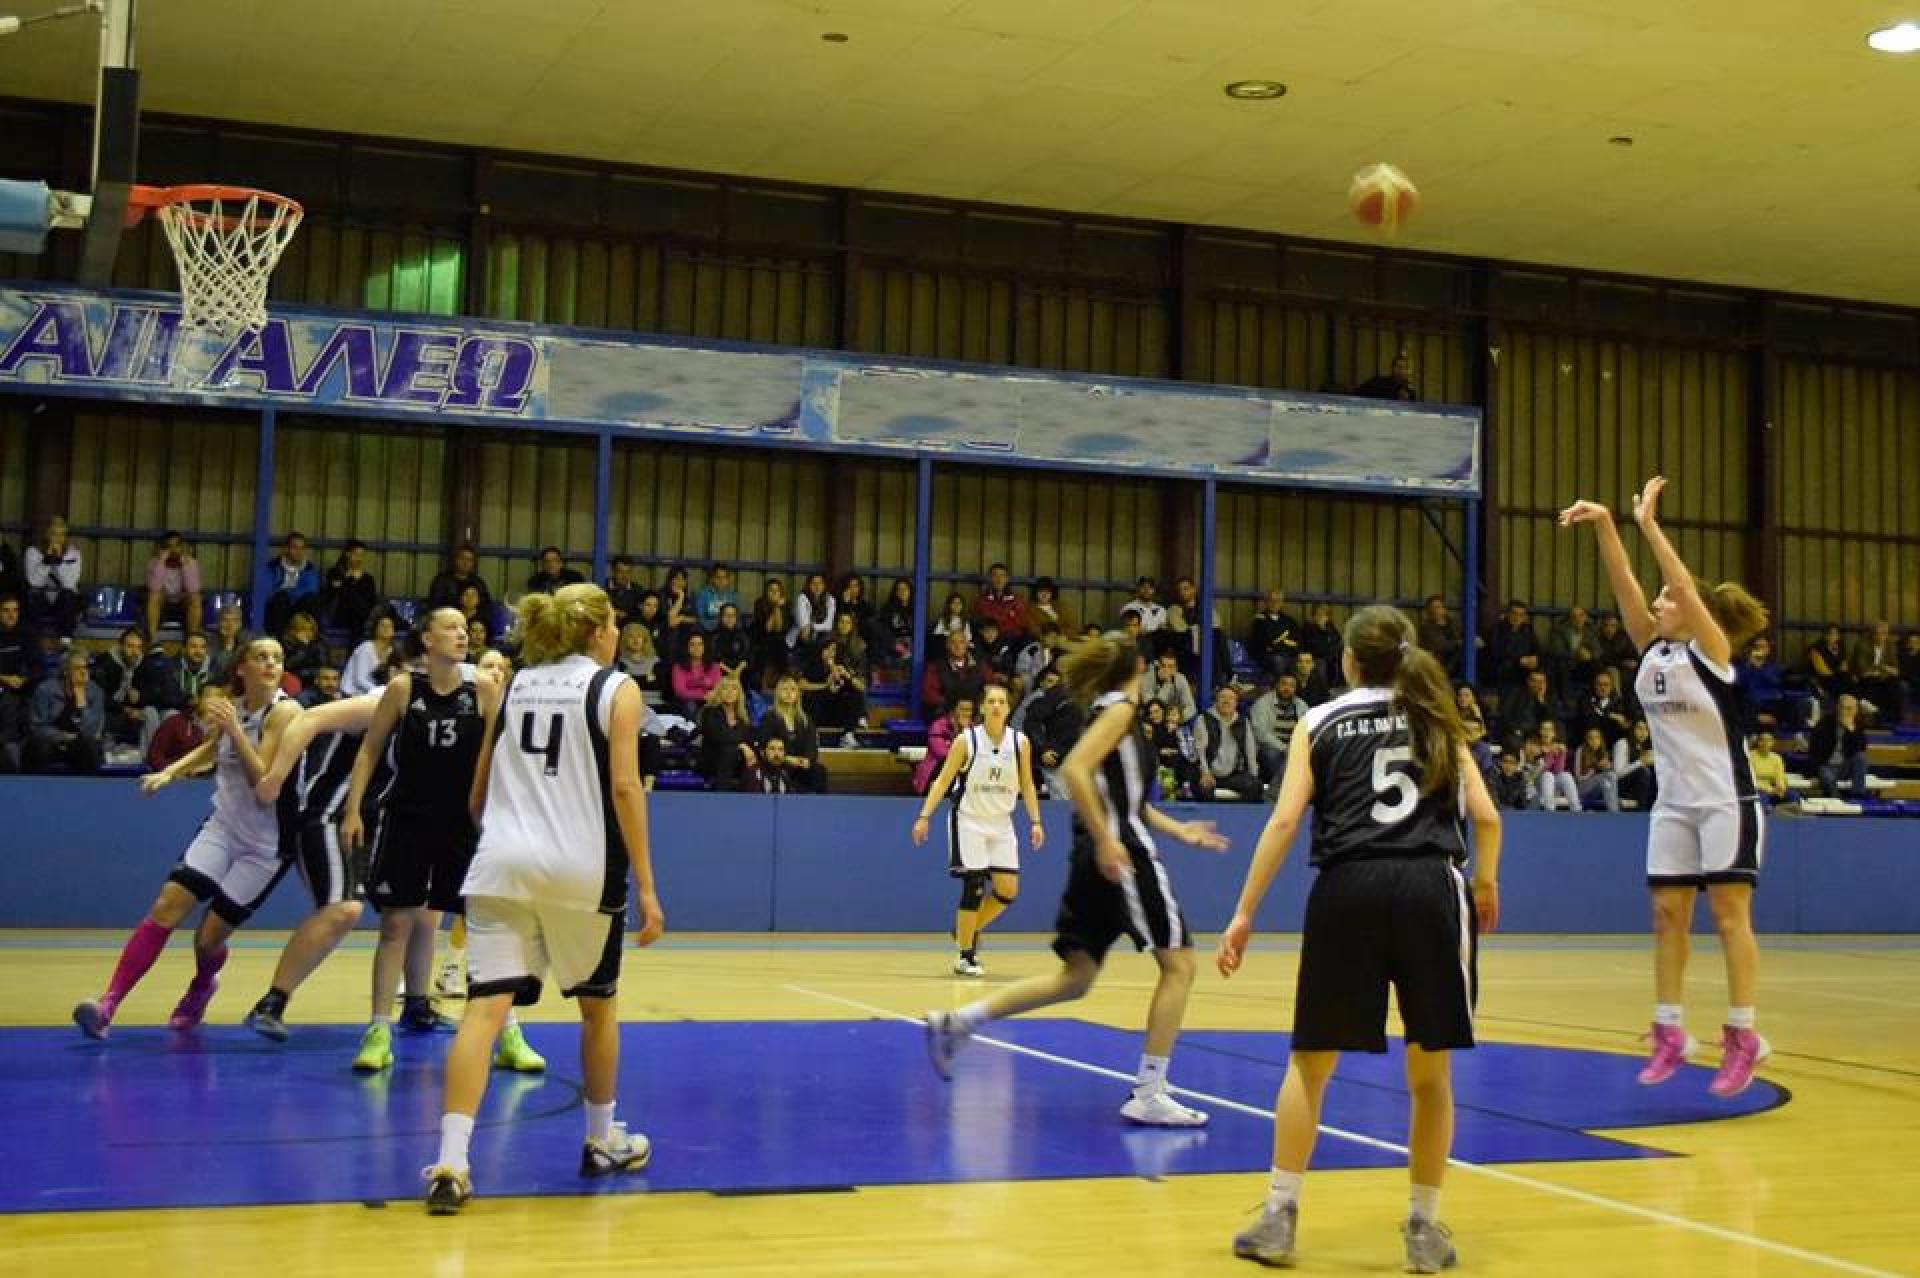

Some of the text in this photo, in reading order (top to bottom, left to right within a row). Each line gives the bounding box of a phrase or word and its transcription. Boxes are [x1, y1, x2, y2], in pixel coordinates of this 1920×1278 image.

[427, 718, 458, 748] 13
[520, 711, 565, 777] 4
[1370, 745, 1419, 824] 5
